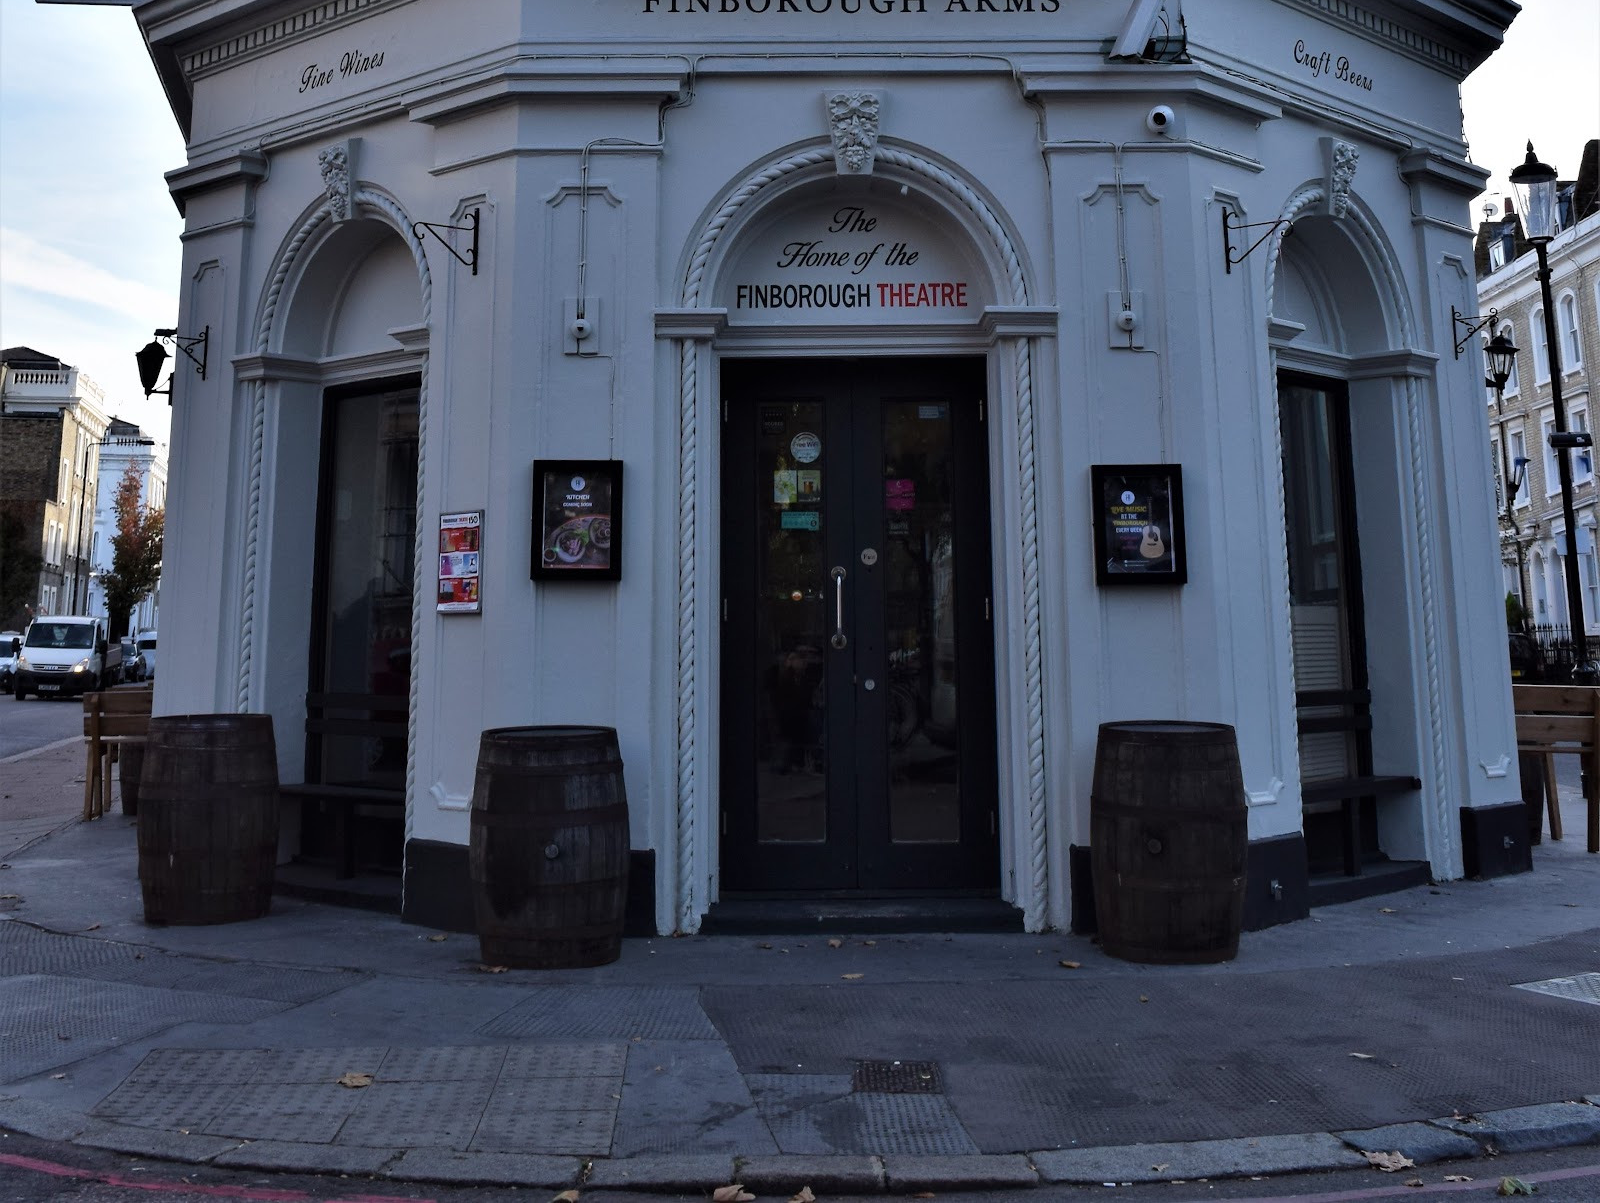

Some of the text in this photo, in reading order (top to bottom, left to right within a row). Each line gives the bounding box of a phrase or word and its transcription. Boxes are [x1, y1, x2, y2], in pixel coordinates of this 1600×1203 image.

[299, 49, 385, 94] Fine Wines
[1293, 39, 1374, 92] Craft Beers
[828, 206, 877, 233] The
[776, 239, 919, 275] Home of the
[736, 282, 968, 309] FINBOROUGH THEATRE
